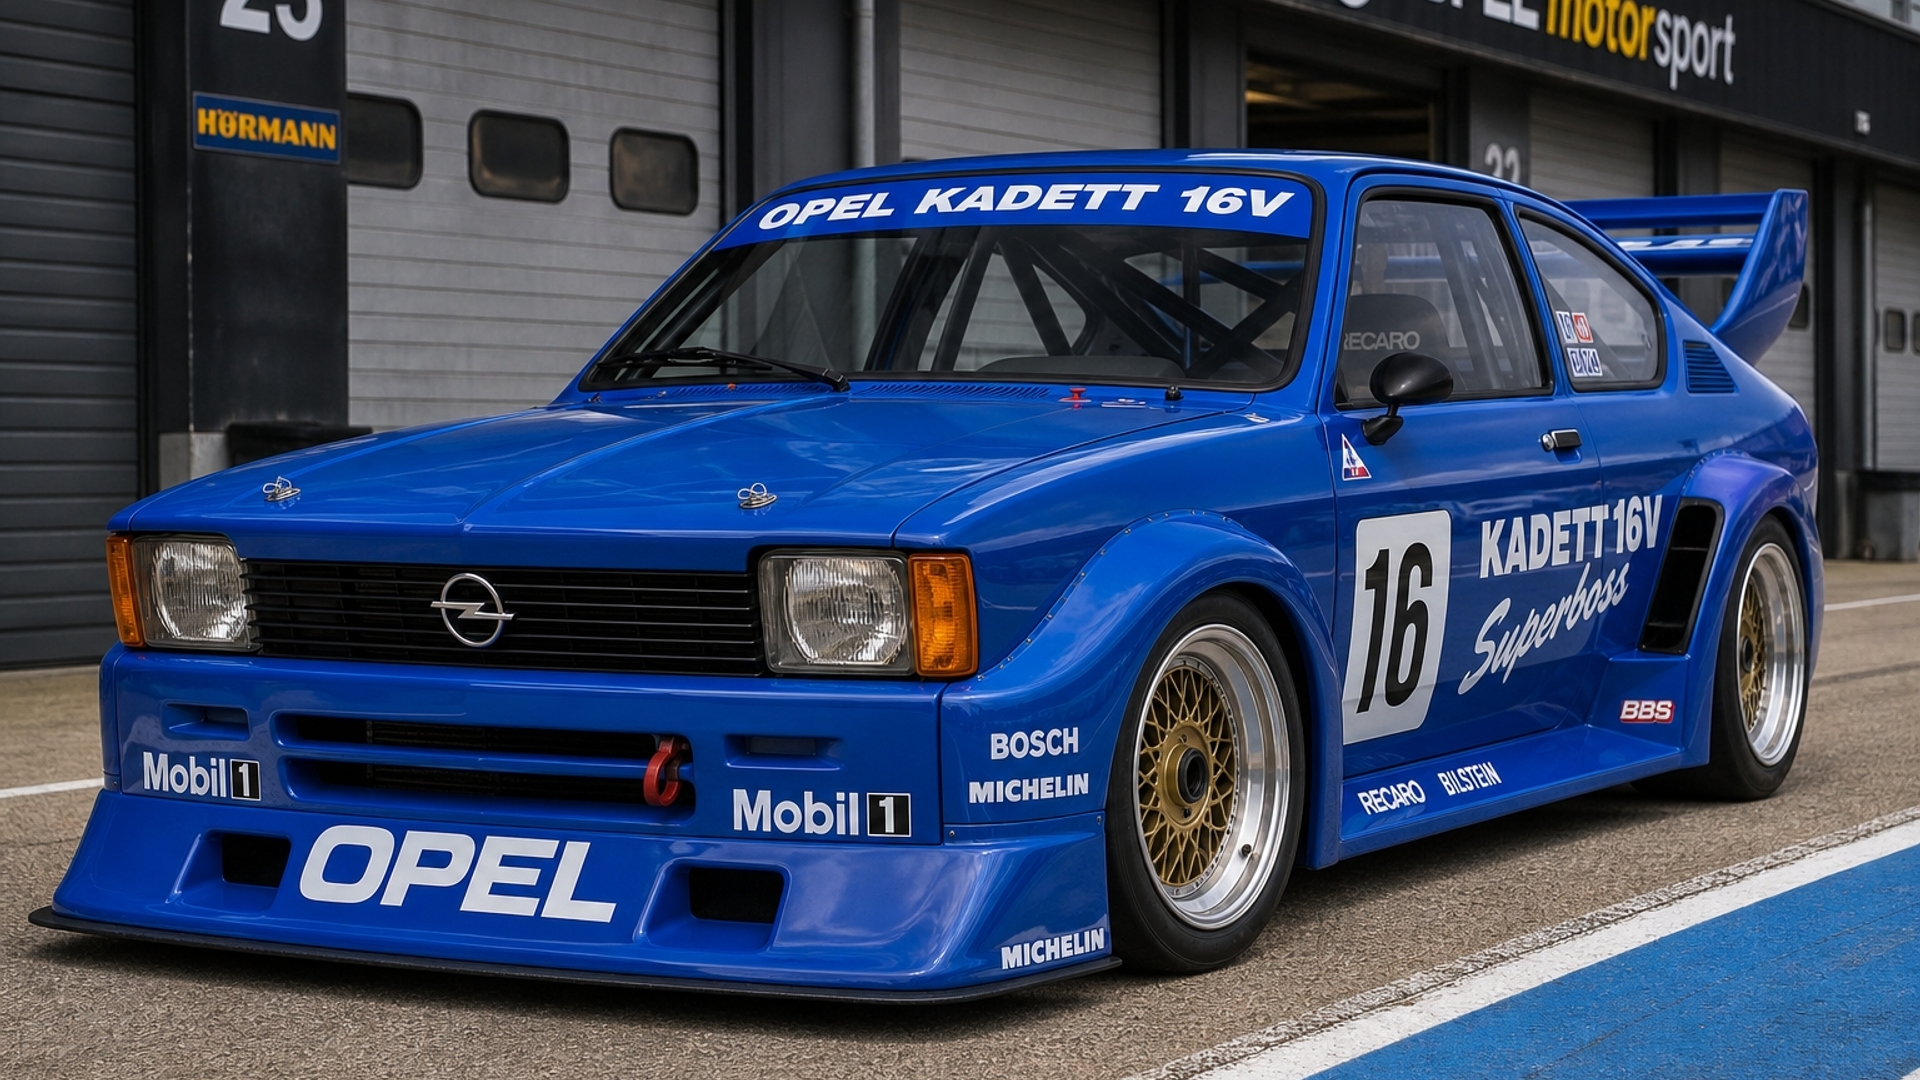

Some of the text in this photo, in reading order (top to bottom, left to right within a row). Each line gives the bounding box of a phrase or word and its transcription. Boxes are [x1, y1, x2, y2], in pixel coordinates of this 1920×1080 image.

[1546, 0, 1735, 90] motorsport
[197, 108, 336, 151] HÖRMANN
[758, 183, 1295, 230] OPEL KADETT 16V
[1479, 494, 1663, 579] KADETT 16V
[1355, 541, 1434, 714] 16
[1458, 560, 1630, 695] Superboss
[1620, 700, 1673, 722] BBS
[990, 727, 1079, 760] BOSCH
[143, 751, 250, 798] Mobil 1
[969, 772, 1089, 804] MICHELIN
[1357, 761, 1502, 815] RECARO BILSTEIN
[733, 788, 859, 836] Mobil
[299, 824, 617, 923] OPEL
[1001, 927, 1105, 970] MICHELIN
